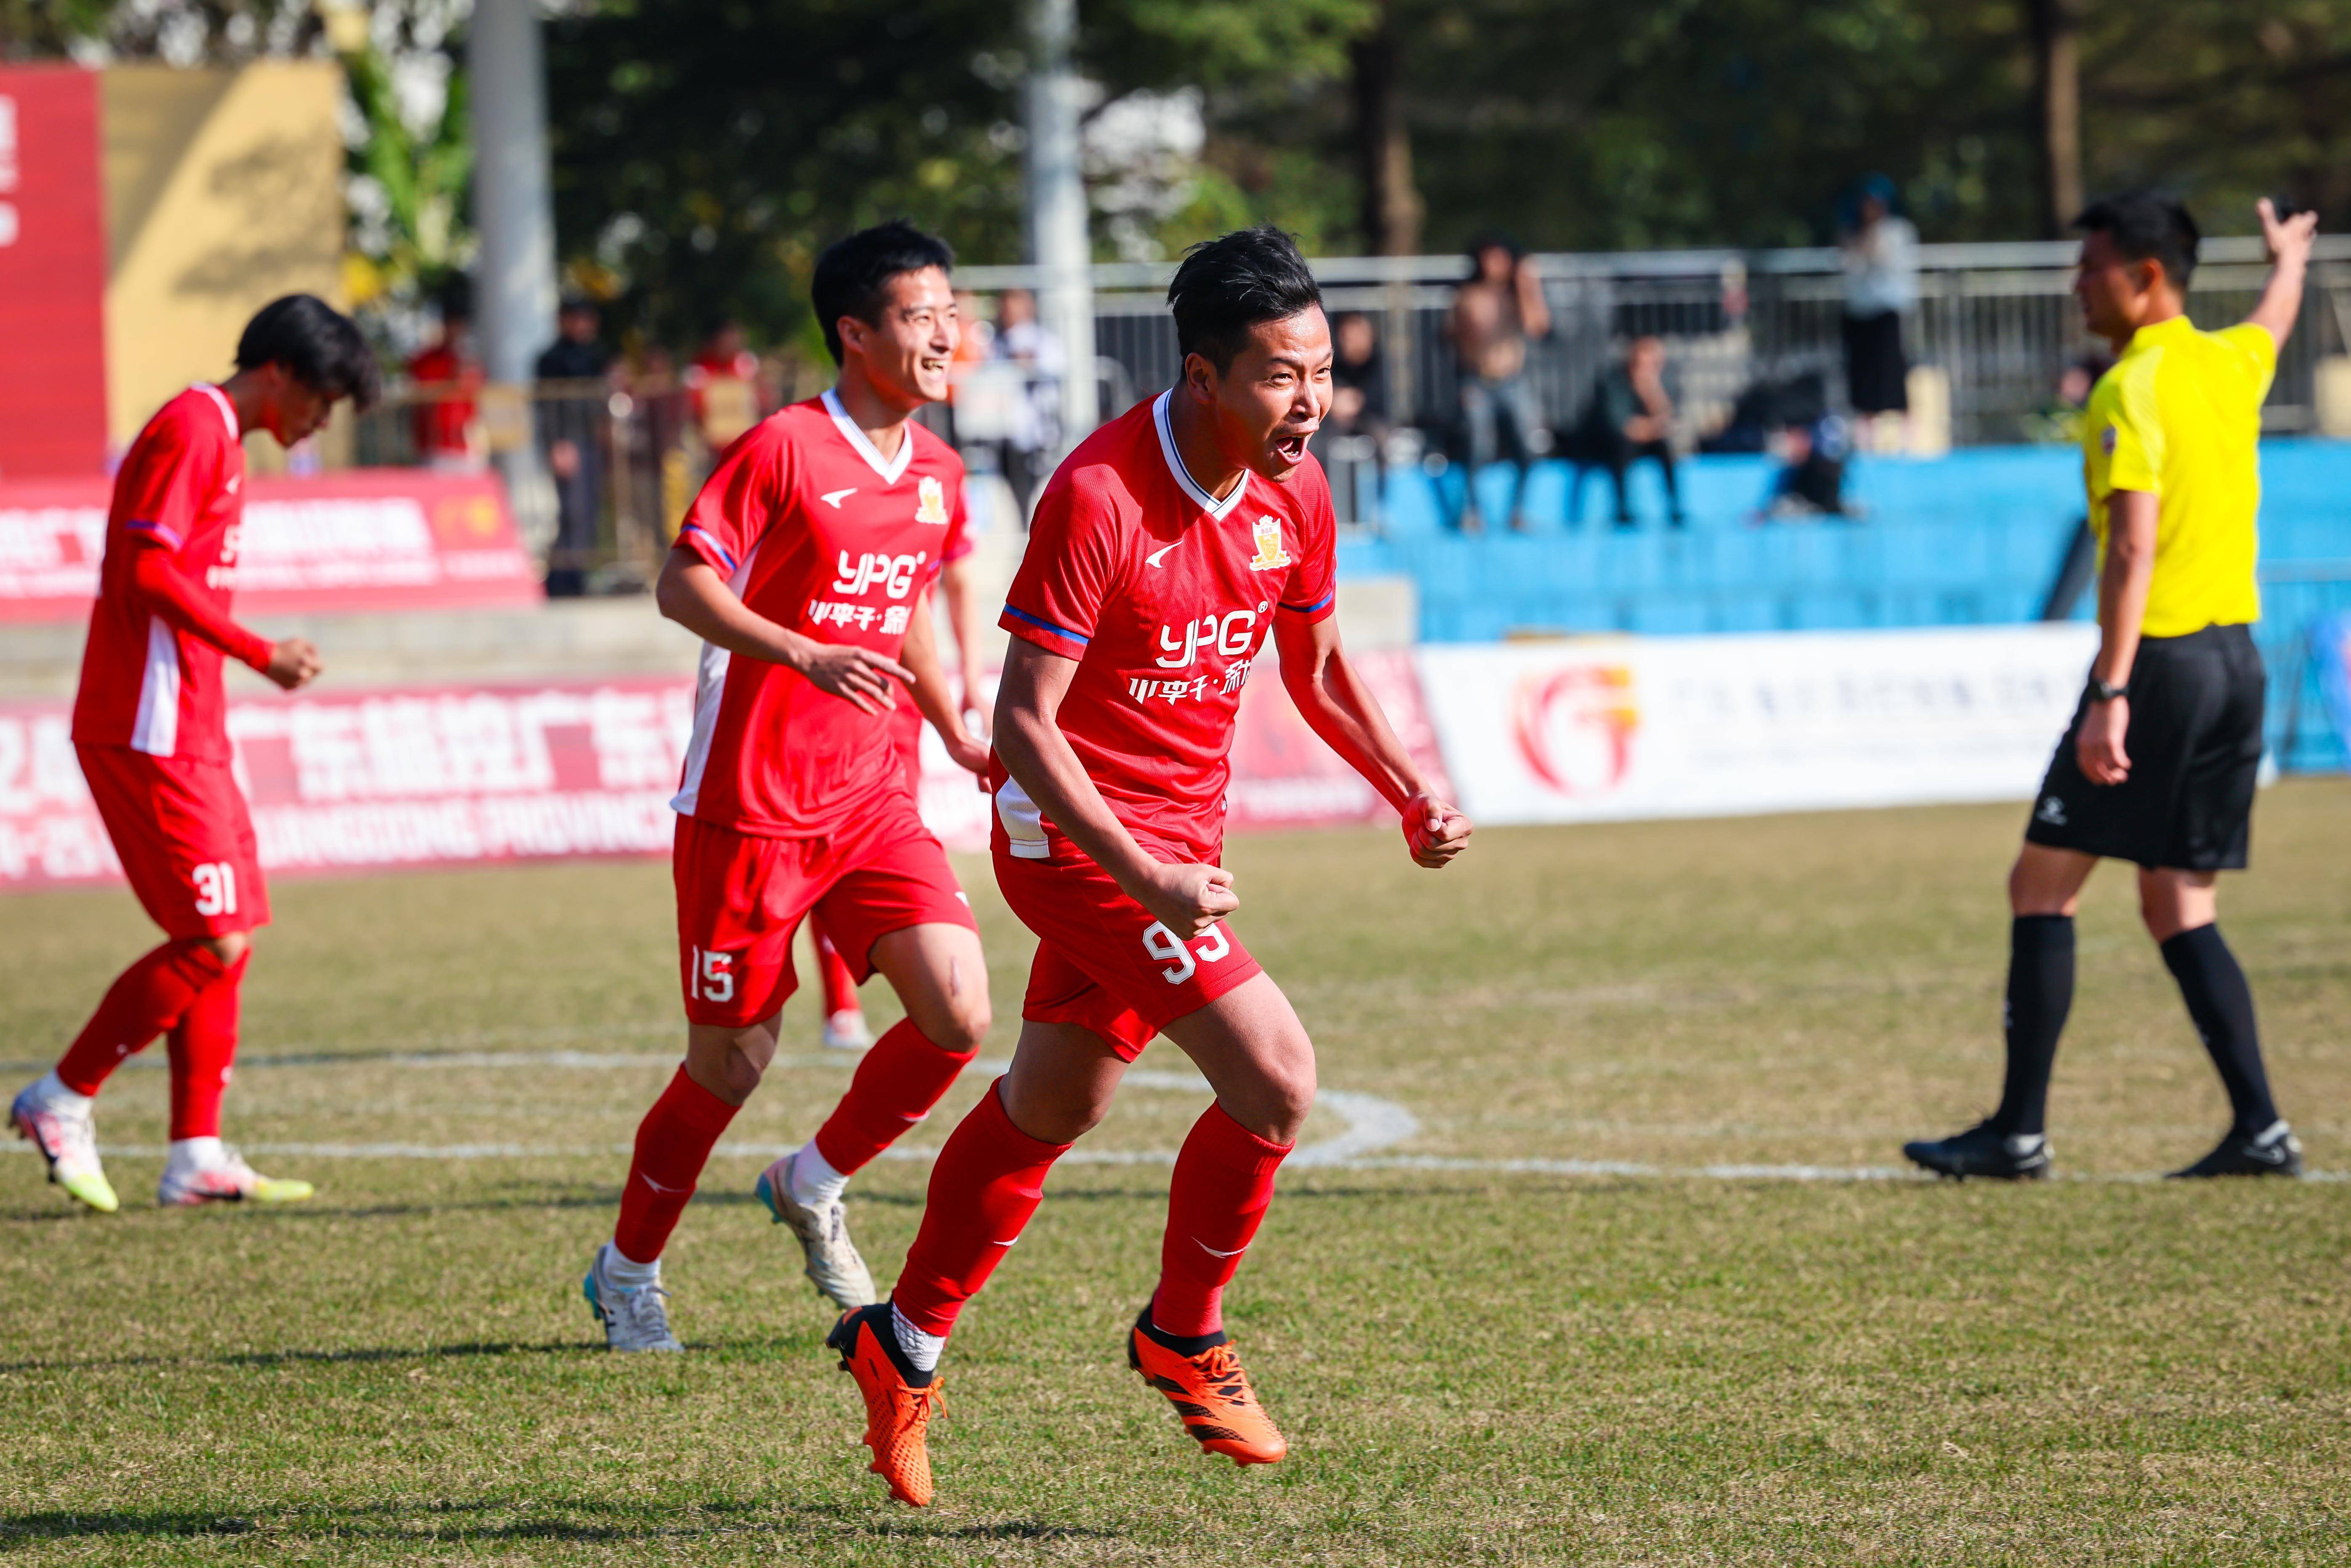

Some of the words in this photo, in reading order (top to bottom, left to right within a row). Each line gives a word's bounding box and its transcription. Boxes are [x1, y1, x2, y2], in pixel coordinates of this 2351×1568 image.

[833, 550, 917, 598] YPG
[1155, 610, 1256, 668] YPG
[192, 862, 237, 915] 31
[691, 944, 734, 1002] 15
